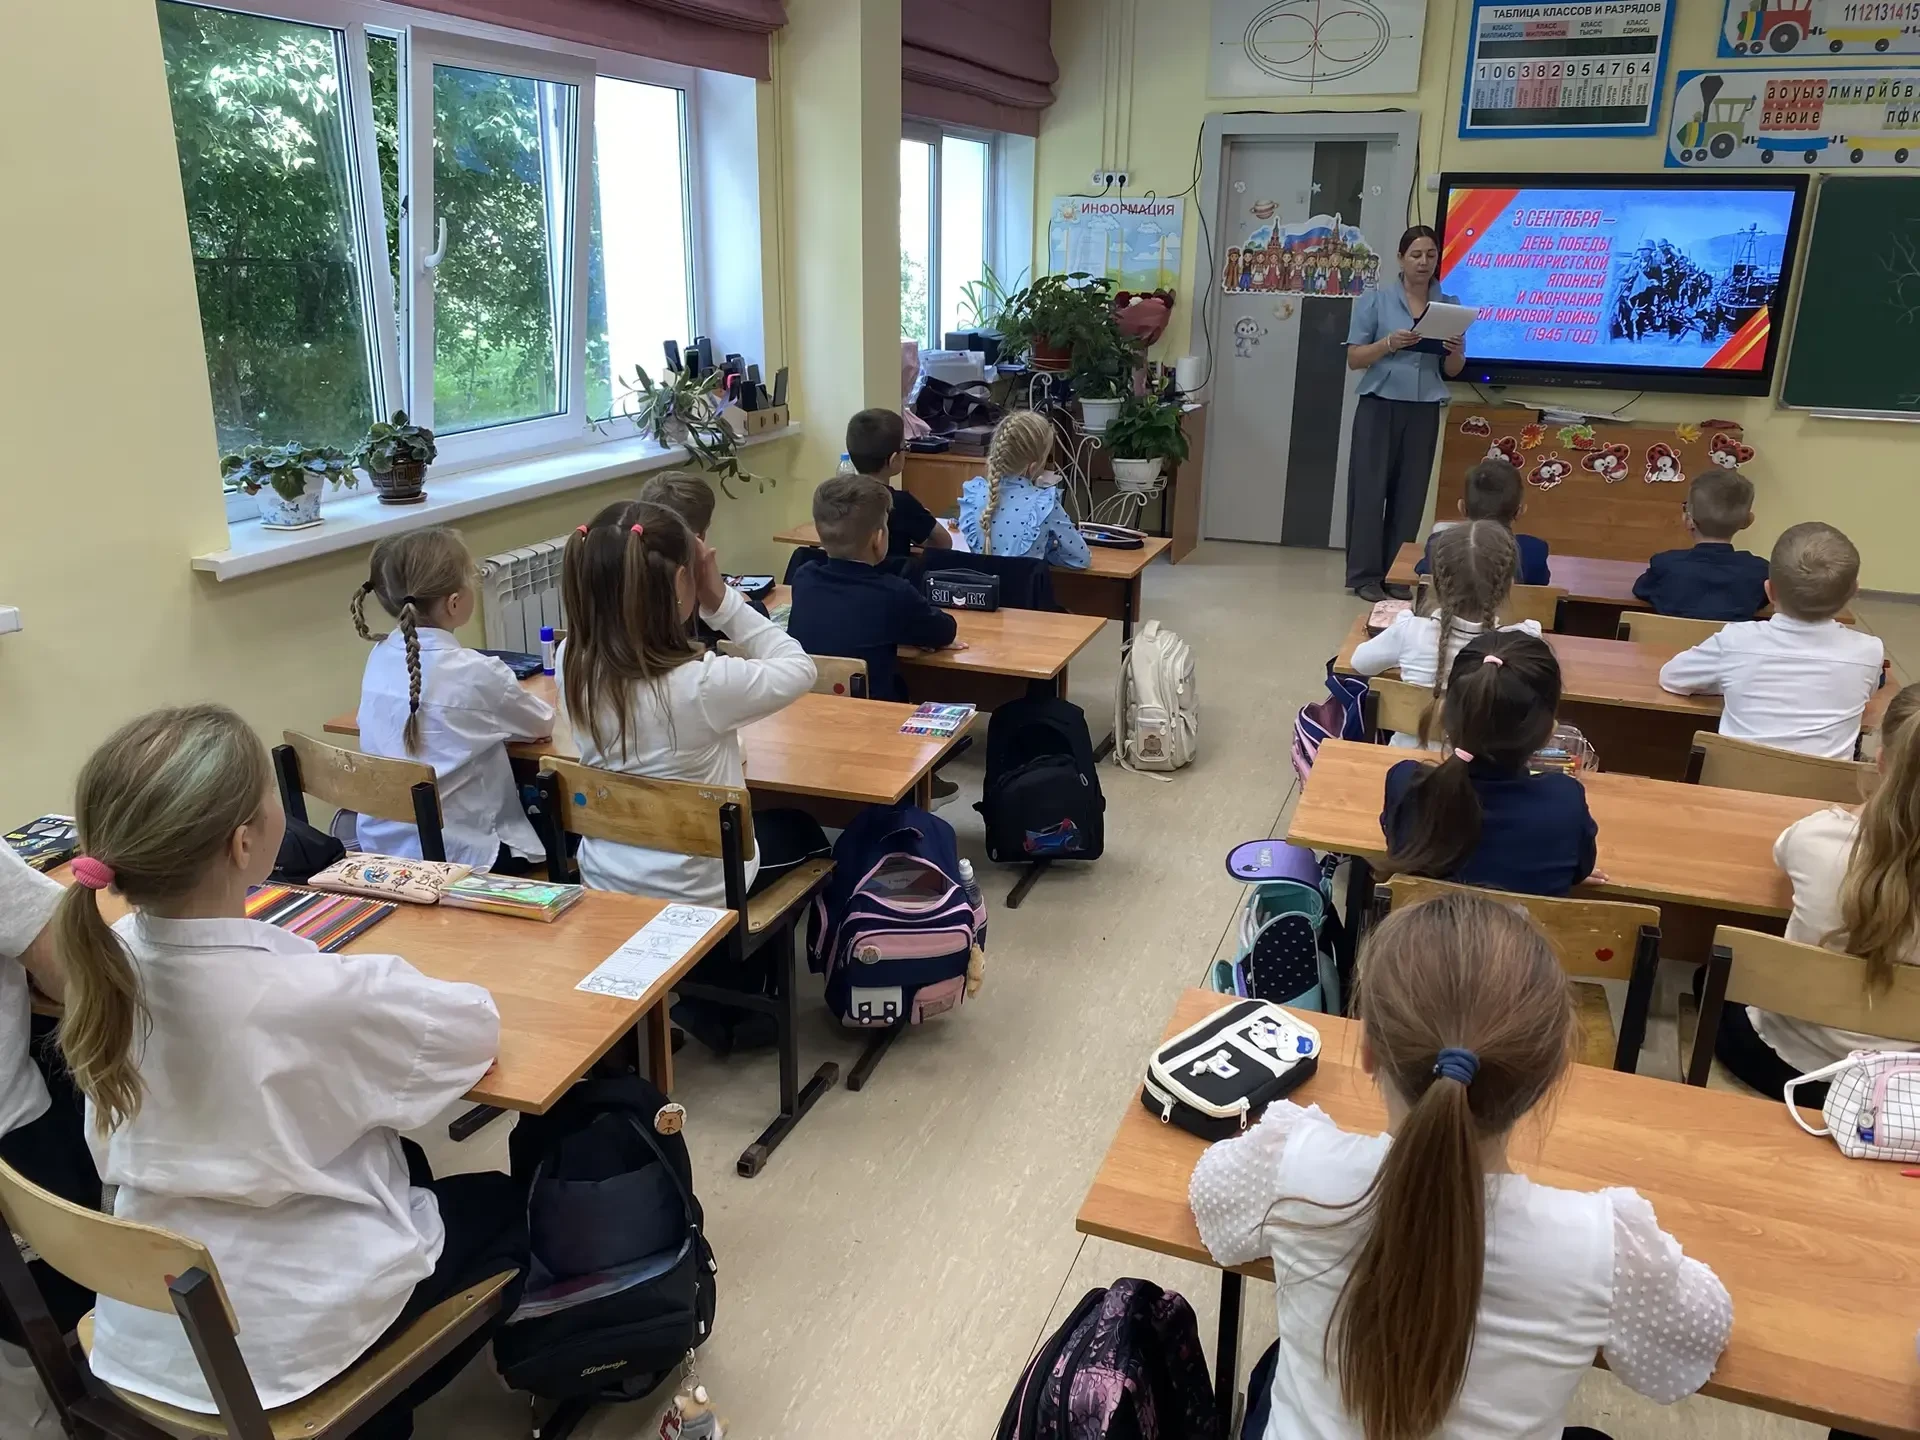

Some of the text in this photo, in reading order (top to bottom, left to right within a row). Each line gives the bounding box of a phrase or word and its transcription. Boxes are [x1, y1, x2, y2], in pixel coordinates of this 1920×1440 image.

[1493, 3, 1661, 18] ТАБЛИЦА КЛАССОВ И РАЗРЯДОВ
[1082, 203, 1175, 217] ИНФОРМАЦИЯ
[1513, 210, 1524, 226] 3
[1525, 209, 1601, 228] СЕНТЯБРЯ
[1520, 236, 1612, 253] ДЕНЬ ПОБЕДЫ
[1466, 253, 1610, 270] НАД МИЛИТАРИСТСКОЙ
[1546, 271, 1607, 289] ЯПОНИЕЙ
[1516, 290, 1604, 307] И ОКОНЧАНИЯ
[1494, 306, 1554, 323] МИРОВОЙ
[1555, 308, 1602, 325] ВОЙНЫ
[1524, 327, 1599, 345] (1945 ГОД)
